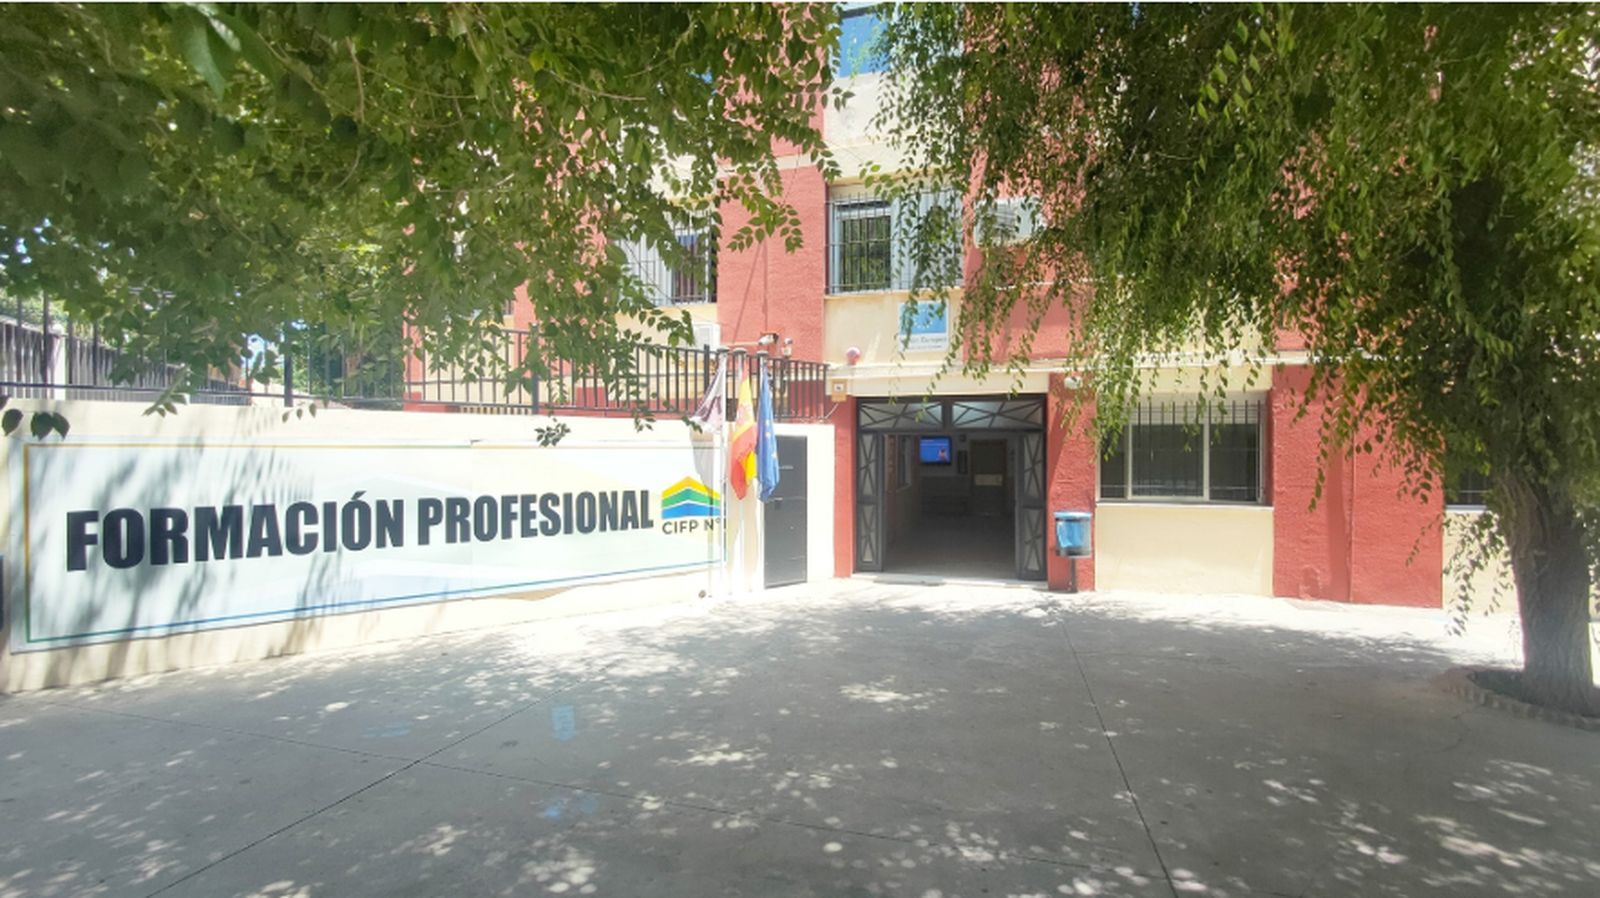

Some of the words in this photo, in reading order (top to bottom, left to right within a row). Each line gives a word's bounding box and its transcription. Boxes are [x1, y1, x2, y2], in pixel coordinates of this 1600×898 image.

[66, 490, 404, 571] FORMACIÓN
[417, 490, 654, 545] PROFESIONAL
[662, 519, 699, 535] CIFP
